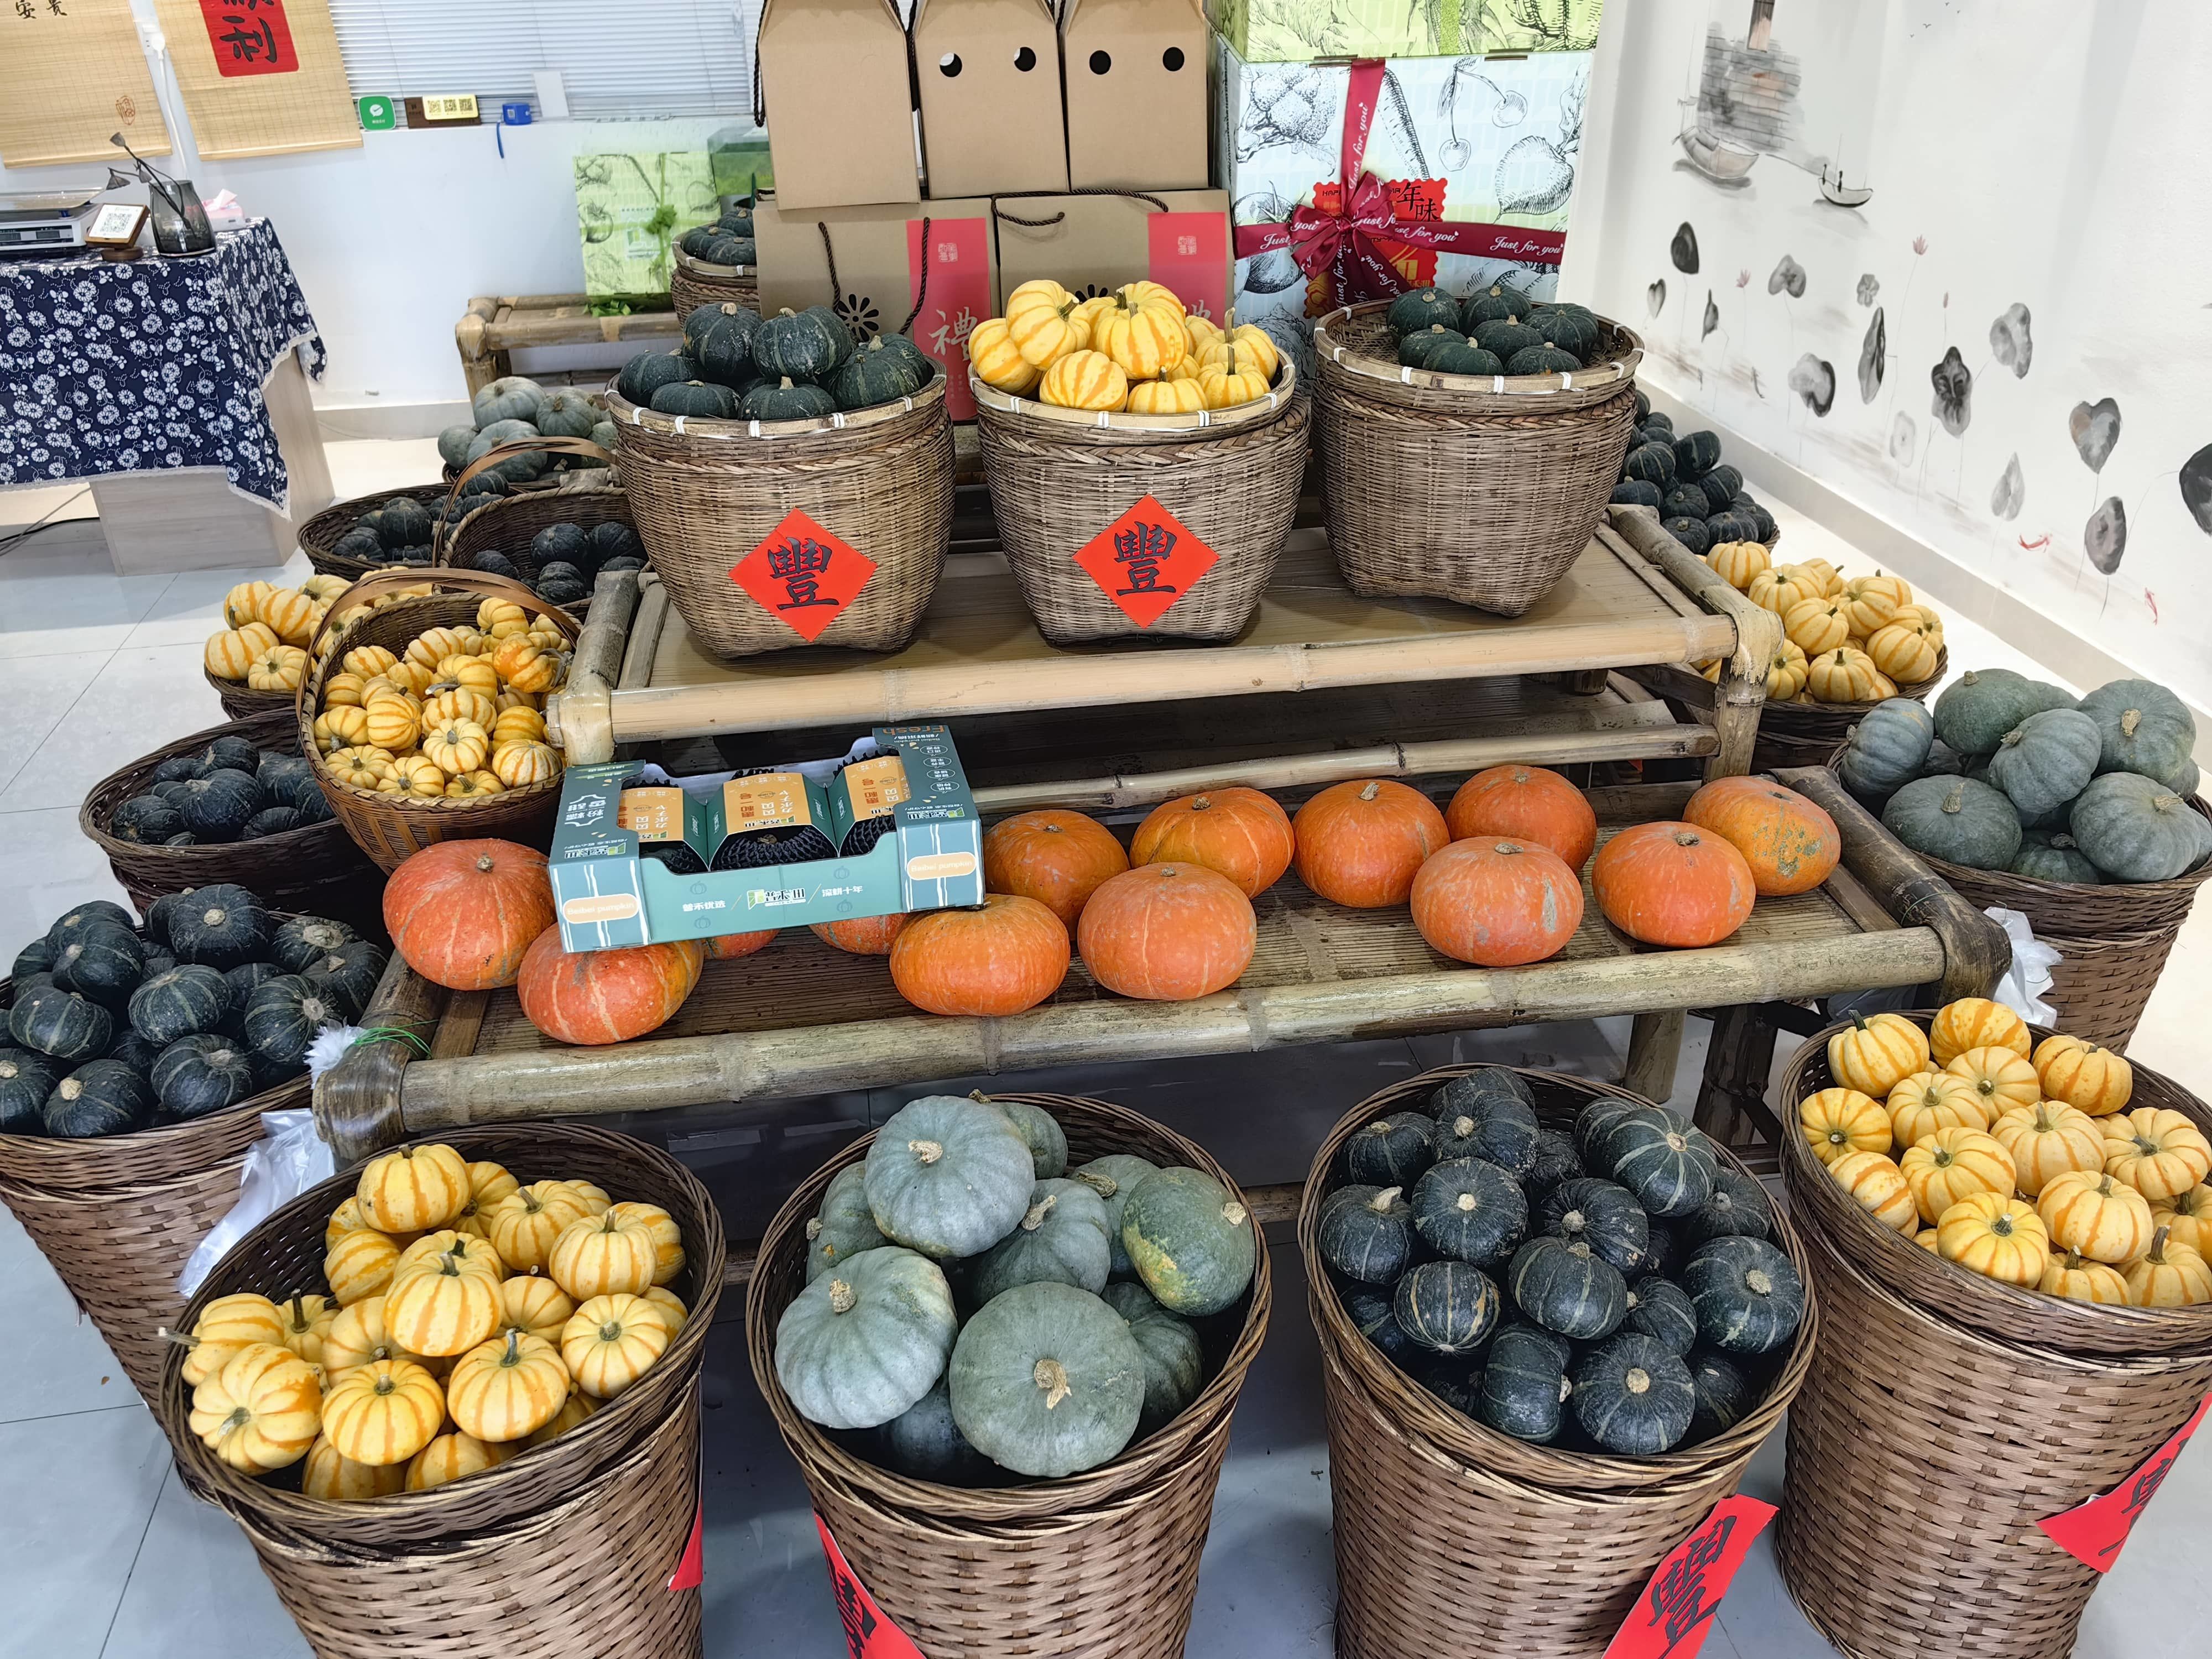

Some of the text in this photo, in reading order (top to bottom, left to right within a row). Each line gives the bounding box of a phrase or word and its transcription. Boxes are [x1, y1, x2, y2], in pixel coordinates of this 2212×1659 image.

[1397, 182, 1438, 221] 年味
[1490, 237, 1561, 256] Just for you
[1113, 521, 1177, 596] 豐
[768, 536, 839, 611] 豐
[883, 726, 945, 735] Fresh
[822, 886, 863, 897] 深耕十年
[682, 900, 726, 912] 普禾优选
